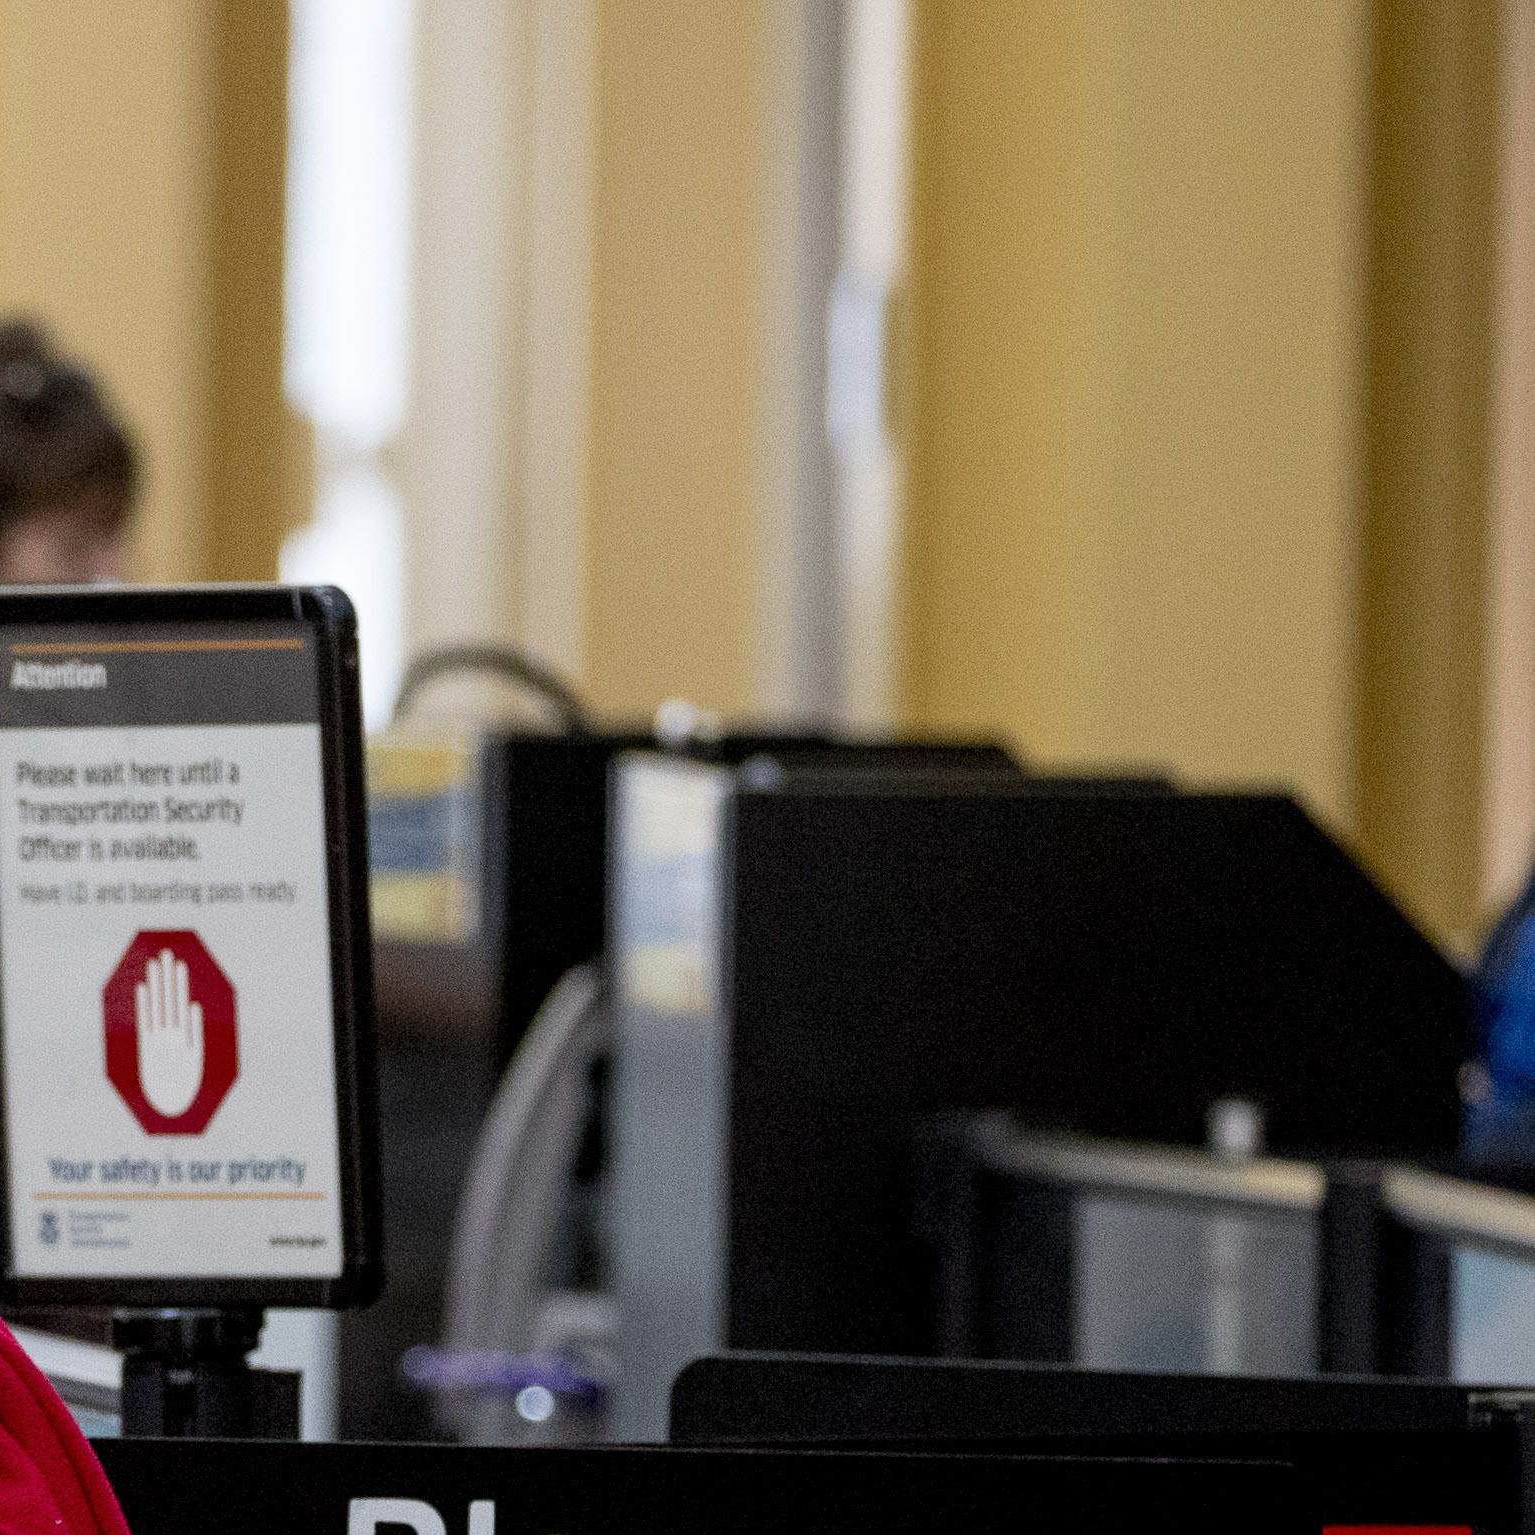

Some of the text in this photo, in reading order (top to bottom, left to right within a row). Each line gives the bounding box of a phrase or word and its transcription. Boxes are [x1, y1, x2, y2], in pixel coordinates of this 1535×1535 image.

[11, 660, 107, 690] Attention
[17, 757, 241, 787] Please wait here until a
[18, 797, 244, 827] Transportation Security
[20, 835, 81, 862] Officer
[89, 837, 104, 862] is
[131, 880, 203, 906] boarding
[48, 1155, 307, 1187] Your safety is our priority
